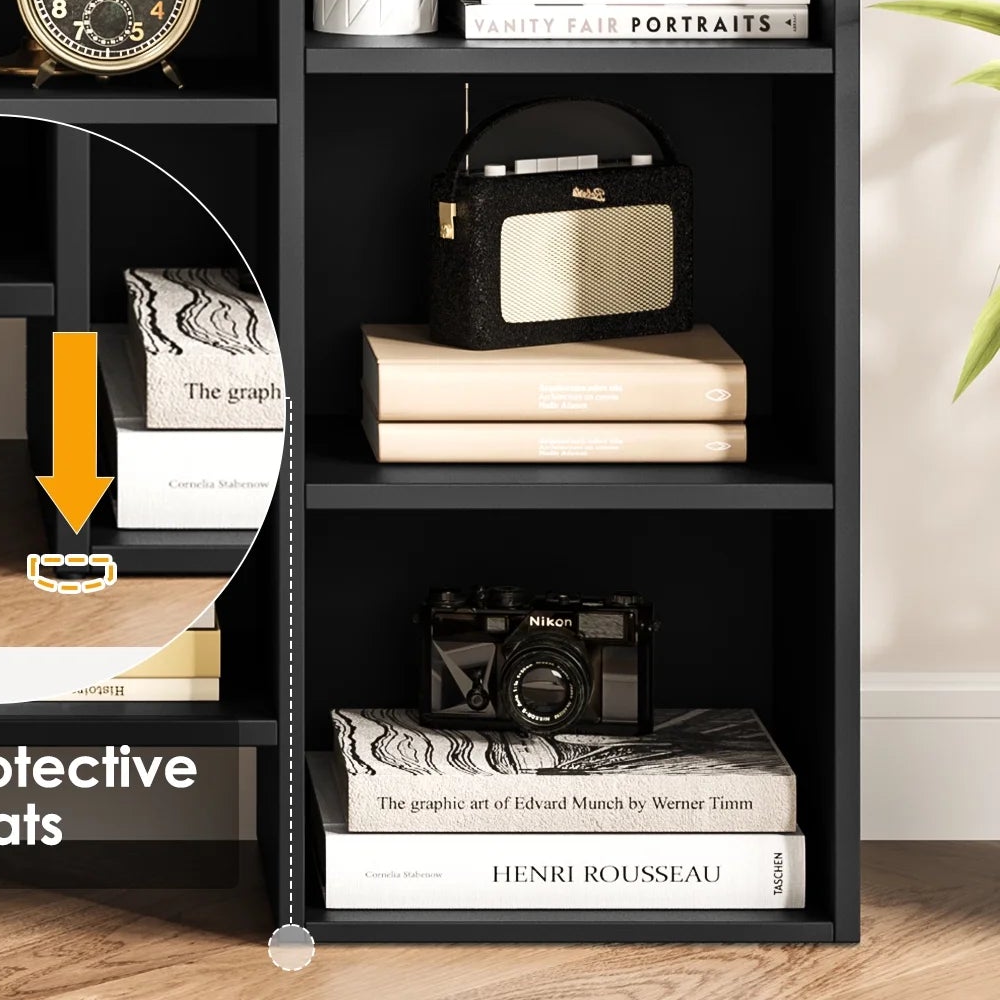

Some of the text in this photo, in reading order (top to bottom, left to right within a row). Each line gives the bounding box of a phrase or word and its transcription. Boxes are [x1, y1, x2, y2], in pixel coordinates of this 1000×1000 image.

[150, 1, 165, 21] 4
[73, 21, 84, 41] 7
[129, 22, 144, 42] 5
[475, 15, 772, 33] VANITY FAIR PORTRAITS
[184, 382, 222, 401] The
[168, 479, 269, 489] Cornelia Stabenow
[529, 616, 573, 627] Nikon
[377, 796, 754, 814] The graphic art of Edvard Munch by Werner Timm
[365, 871, 443, 879] Cornelia Stabenow
[492, 865, 722, 883] HENRI ROUSSEAU
[774, 852, 783, 896] TASCHEN
